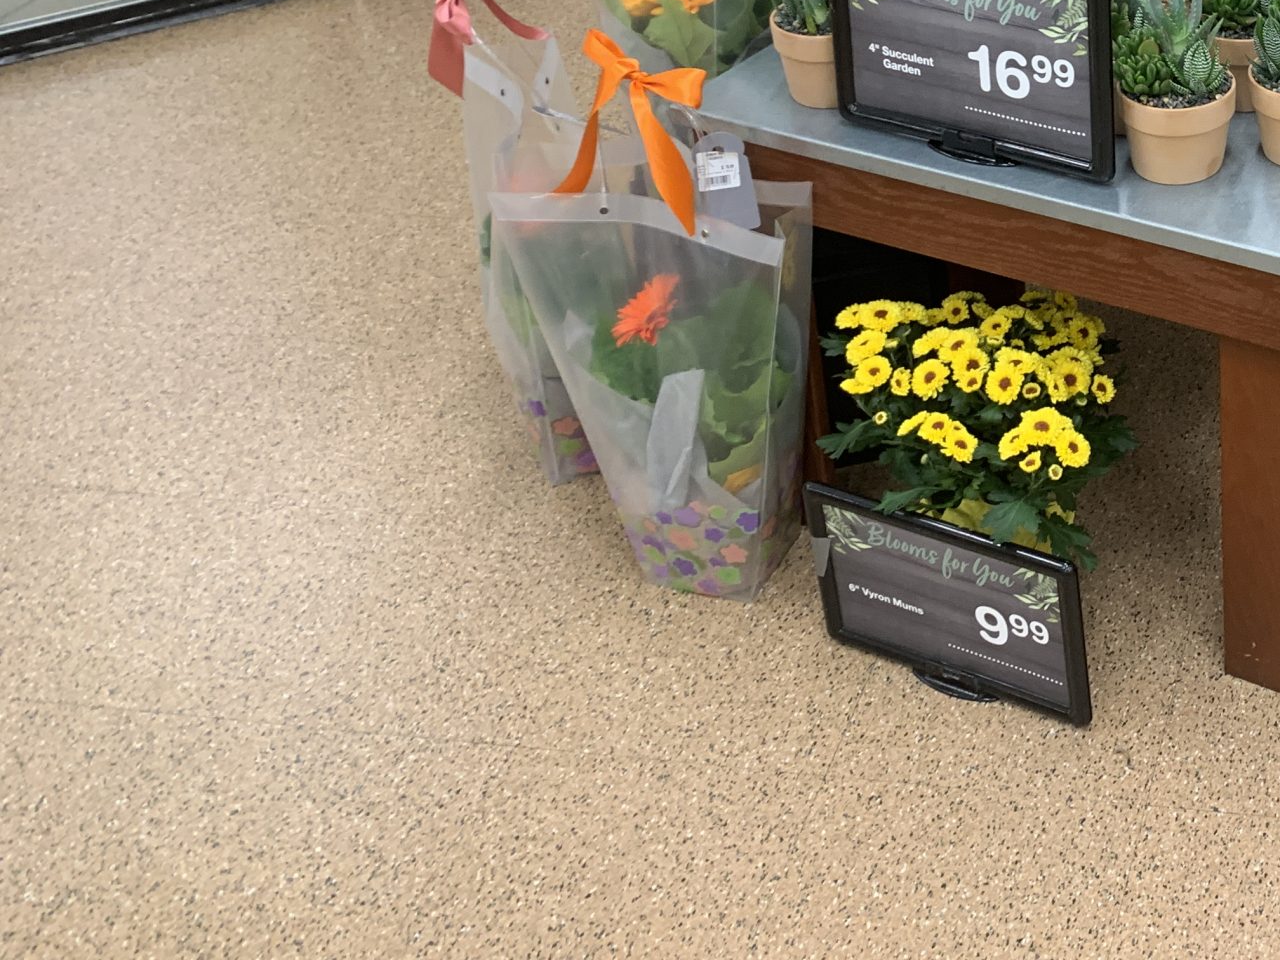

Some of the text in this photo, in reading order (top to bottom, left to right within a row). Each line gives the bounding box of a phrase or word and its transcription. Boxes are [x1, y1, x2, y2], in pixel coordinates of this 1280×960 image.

[868, 42, 935, 68] 4" Succulent
[883, 58, 922, 77] Garden
[865, 521, 1016, 588] Blooms for You
[861, 586, 891, 604] Vyron
[892, 596, 925, 616] Mums
